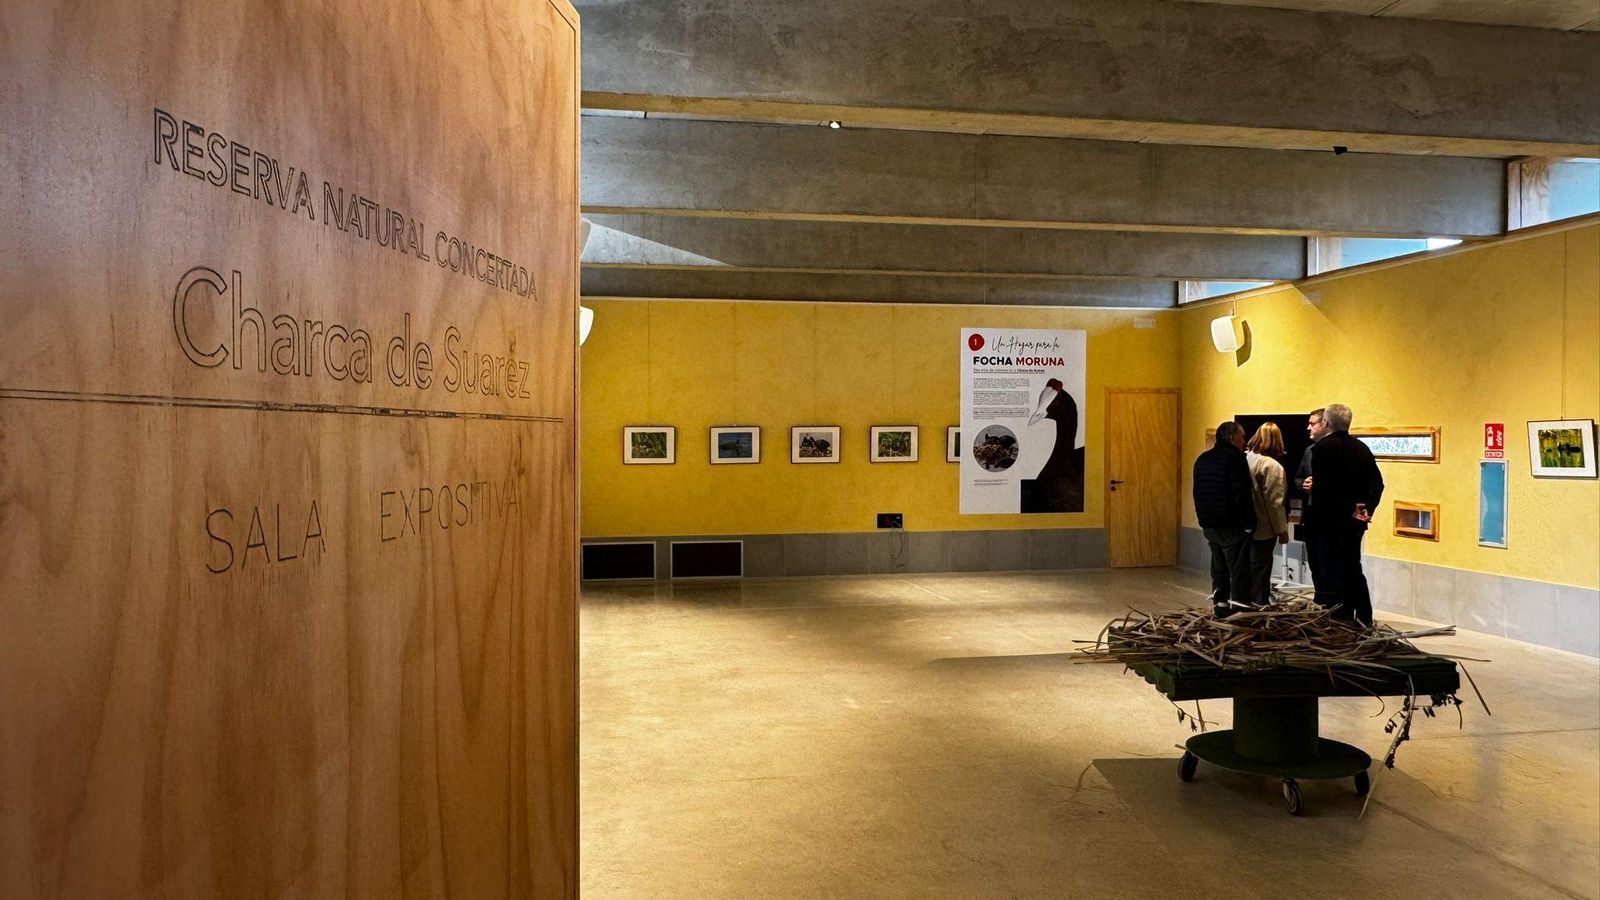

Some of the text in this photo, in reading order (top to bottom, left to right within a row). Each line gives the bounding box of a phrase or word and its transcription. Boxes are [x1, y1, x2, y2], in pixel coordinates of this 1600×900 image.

[153, 107, 538, 302] RESERVA NATURAL CONCERTADA
[172, 265, 373, 384] Charca
[386, 312, 433, 390] de
[973, 356, 1065, 366] FOCHA MORUNA
[992, 336, 1060, 355] Un Hogar para la
[205, 479, 520, 574] SALA EXPOSITIVA
